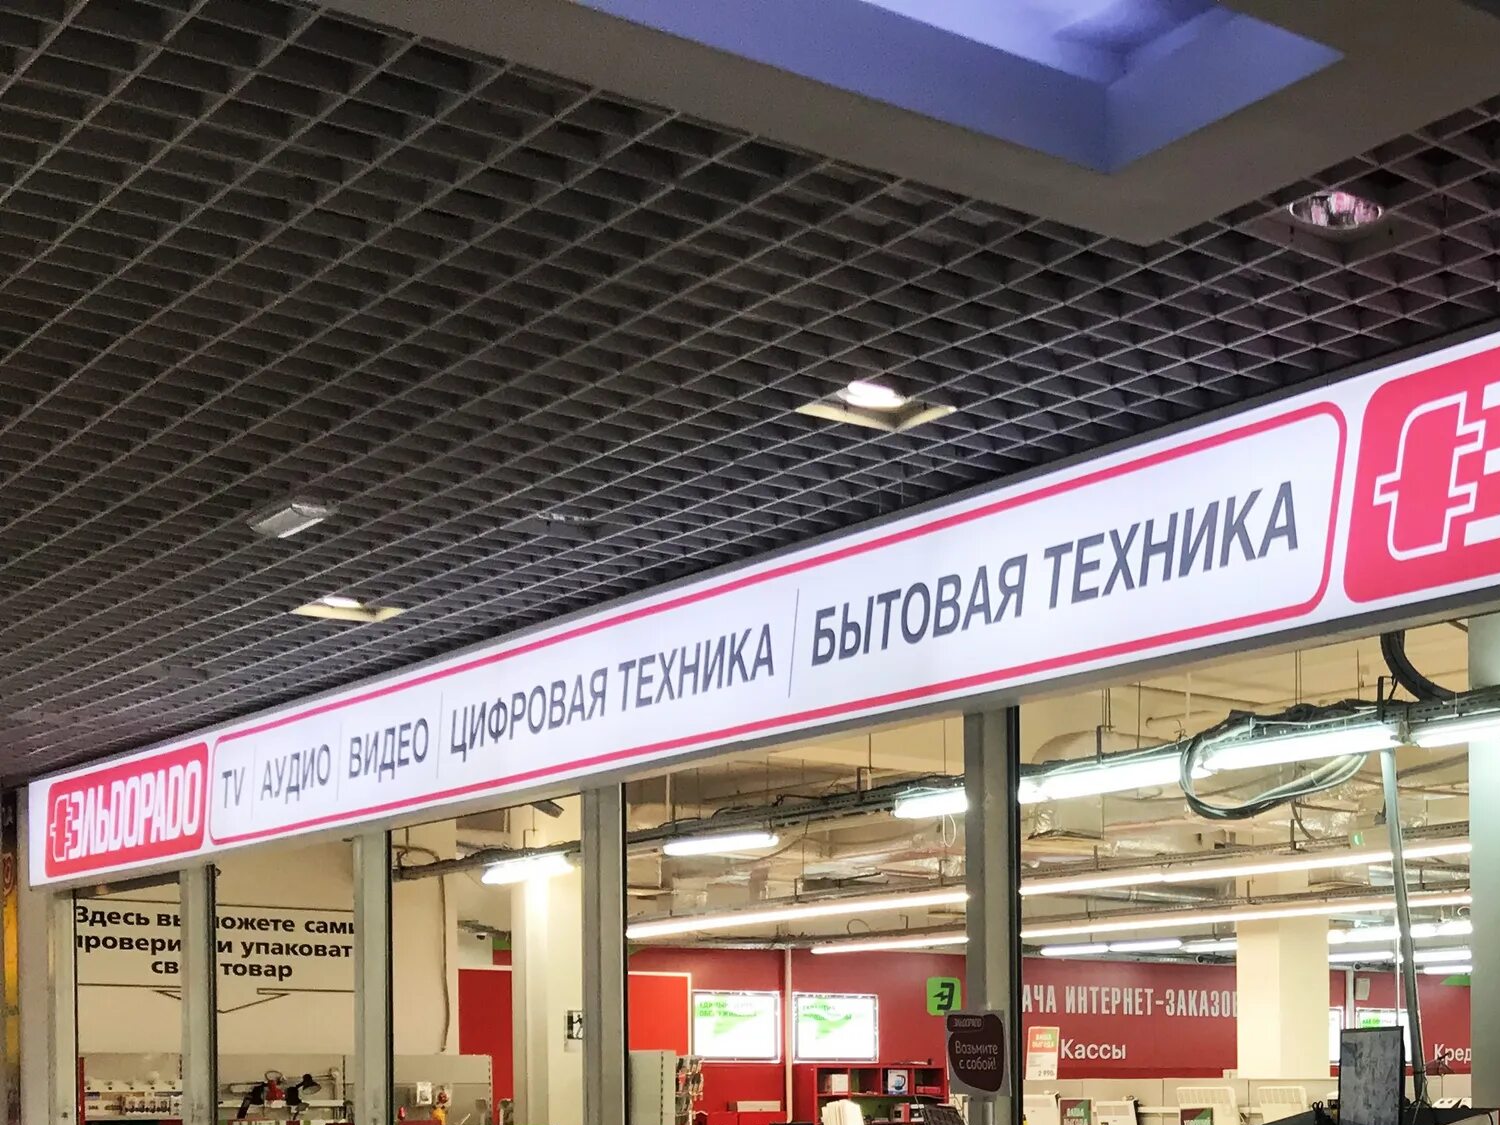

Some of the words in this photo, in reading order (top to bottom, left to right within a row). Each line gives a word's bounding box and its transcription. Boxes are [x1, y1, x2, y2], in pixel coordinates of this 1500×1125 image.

[222, 767, 246, 808] TV
[260, 744, 331, 804] АУДИО
[348, 718, 429, 782] ВИДЕО
[450, 667, 608, 762] ЦИФРОВАЯ
[618, 623, 774, 711] ТЕХНИКА
[811, 554, 1027, 667] БЫТОВАЯ
[1043, 480, 1298, 609] ТЕХНИКА
[76, 905, 149, 927] Здесь
[77, 934, 181, 954] ровери
[218, 941, 232, 953] и
[240, 940, 352, 958] упаковат
[220, 962, 293, 981] товар
[955, 1040, 998, 1055] Возьмите
[1061, 1038, 1126, 1060] Кассы
[966, 1056, 997, 1071] собой!
